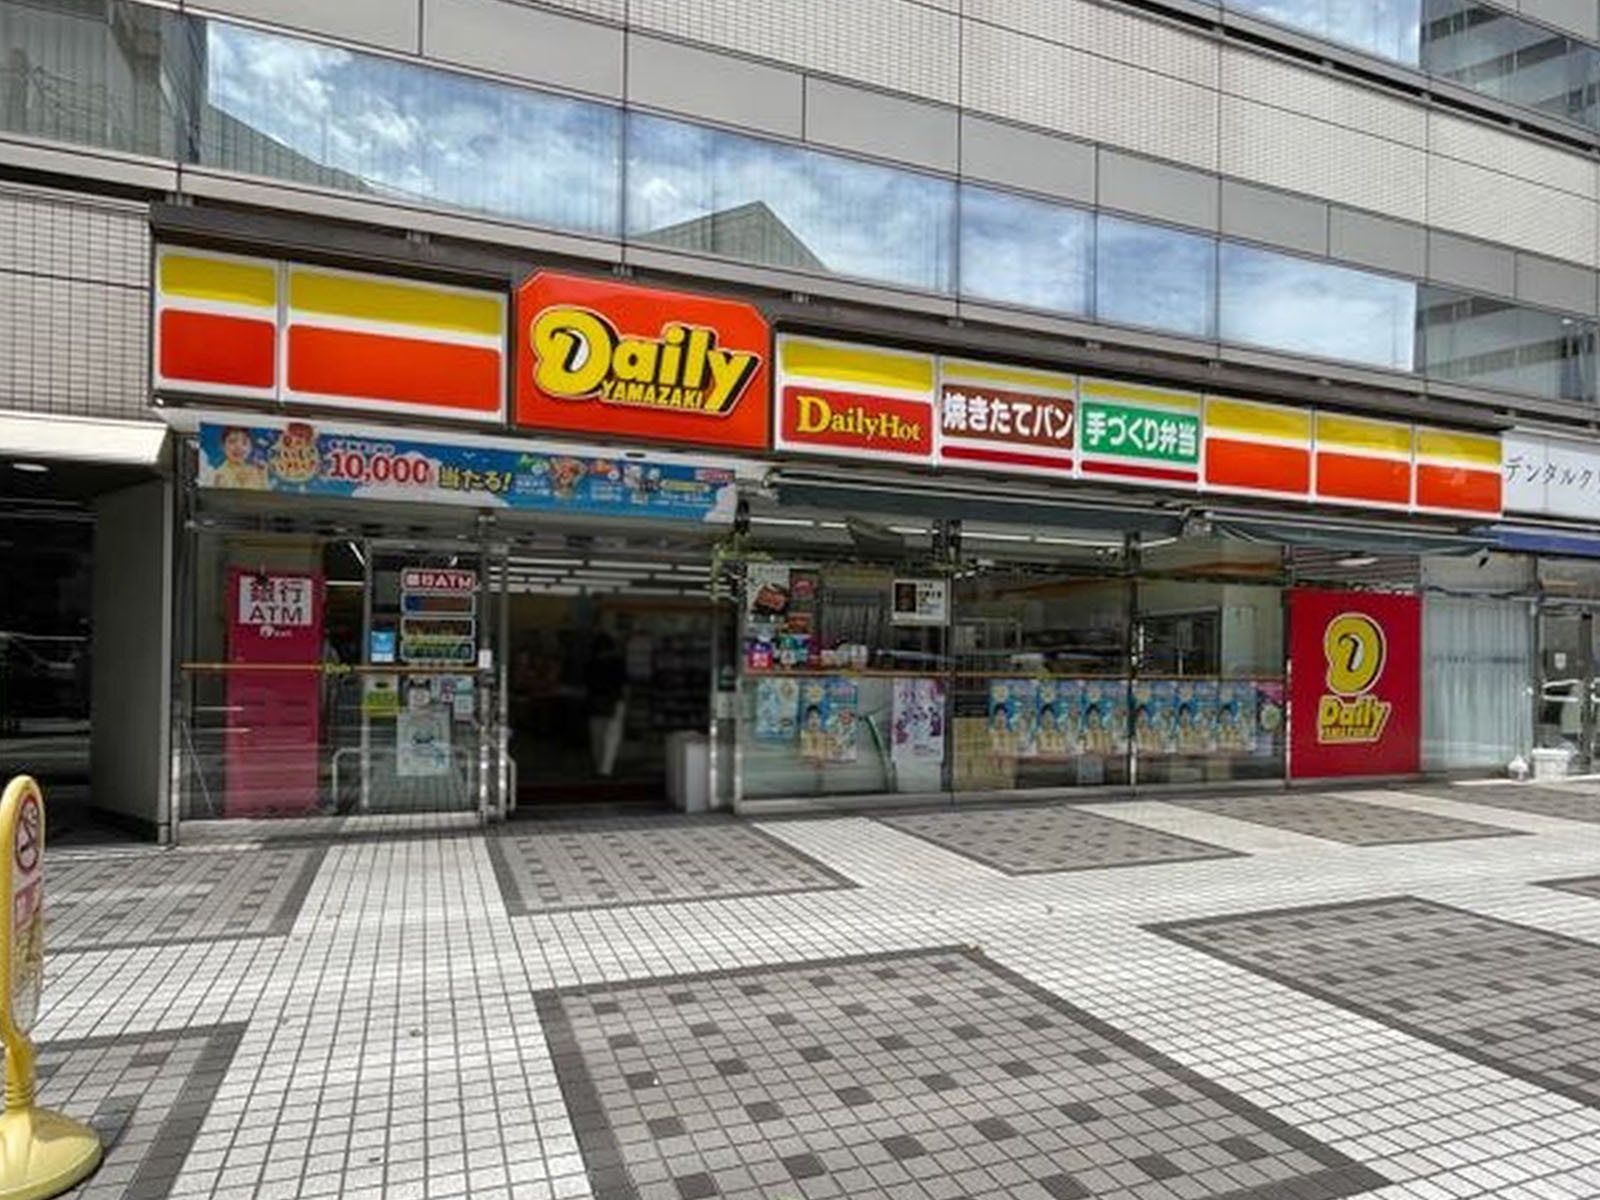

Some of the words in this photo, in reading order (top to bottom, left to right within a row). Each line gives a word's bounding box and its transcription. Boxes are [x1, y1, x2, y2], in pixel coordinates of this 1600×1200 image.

[532, 306, 759, 414] Daily
[602, 380, 704, 409] YAMAZAKI
[795, 394, 922, 442] DailyHot
[942, 391, 1073, 439] 焼きたてパン
[1085, 410, 1197, 457] 手づくり弁当
[1505, 455, 1600, 490] デンタルク
[248, 604, 303, 623] ATM
